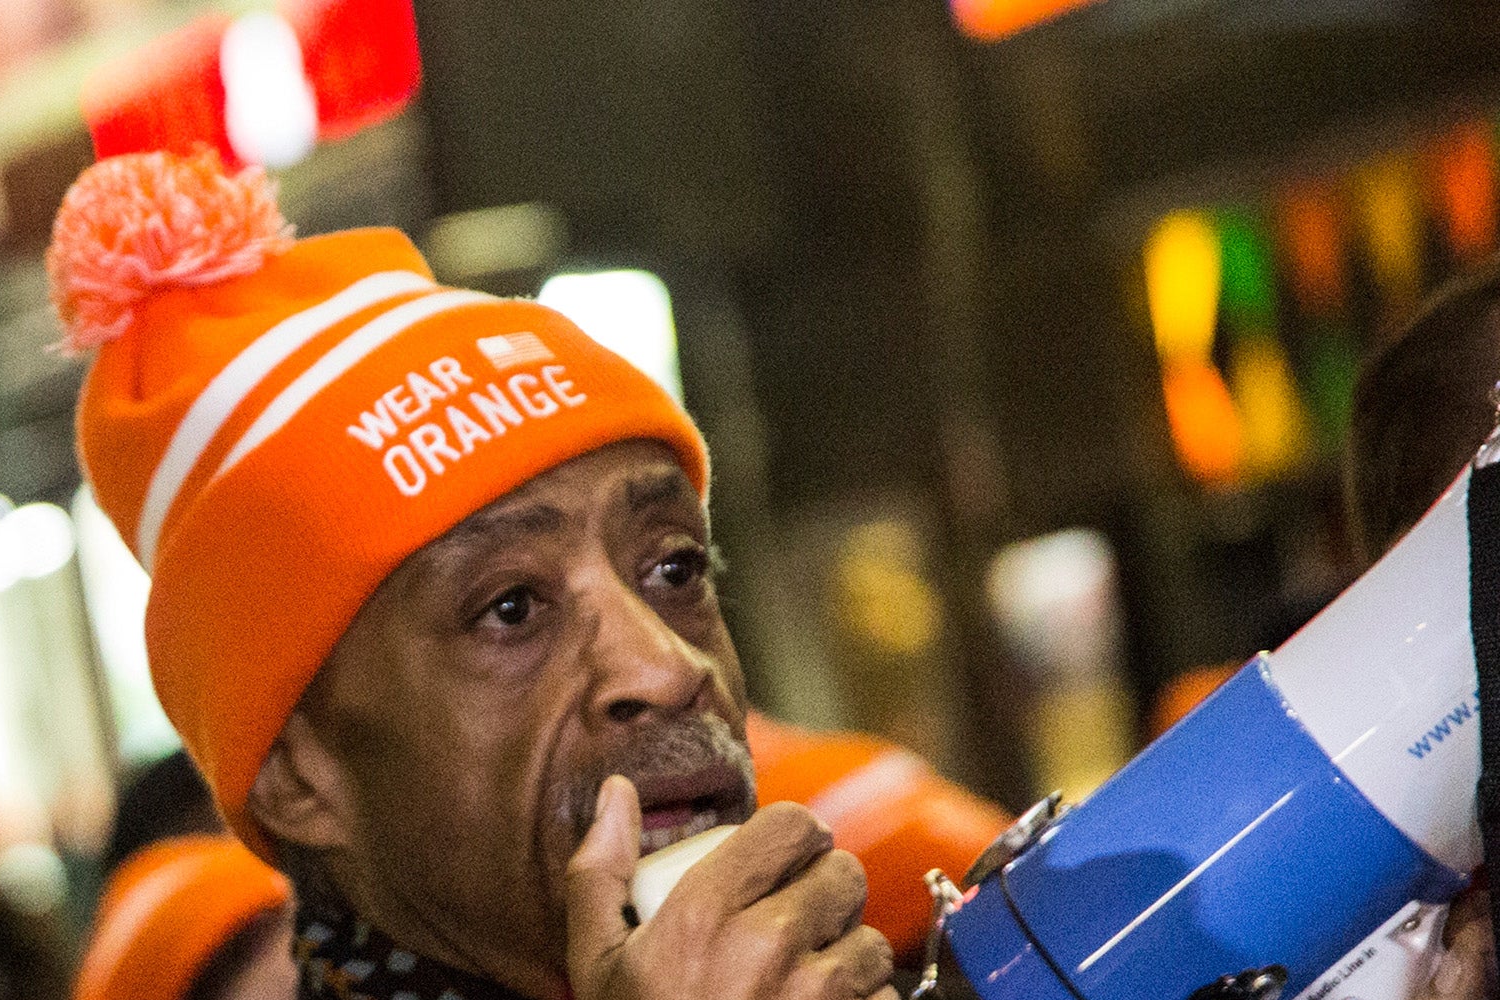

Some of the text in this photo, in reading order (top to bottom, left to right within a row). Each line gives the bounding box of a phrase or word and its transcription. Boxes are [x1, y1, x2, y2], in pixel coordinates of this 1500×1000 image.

[347, 356, 473, 449] WEAR
[383, 365, 587, 496] ORANGE
[1407, 689, 1480, 759] www.
